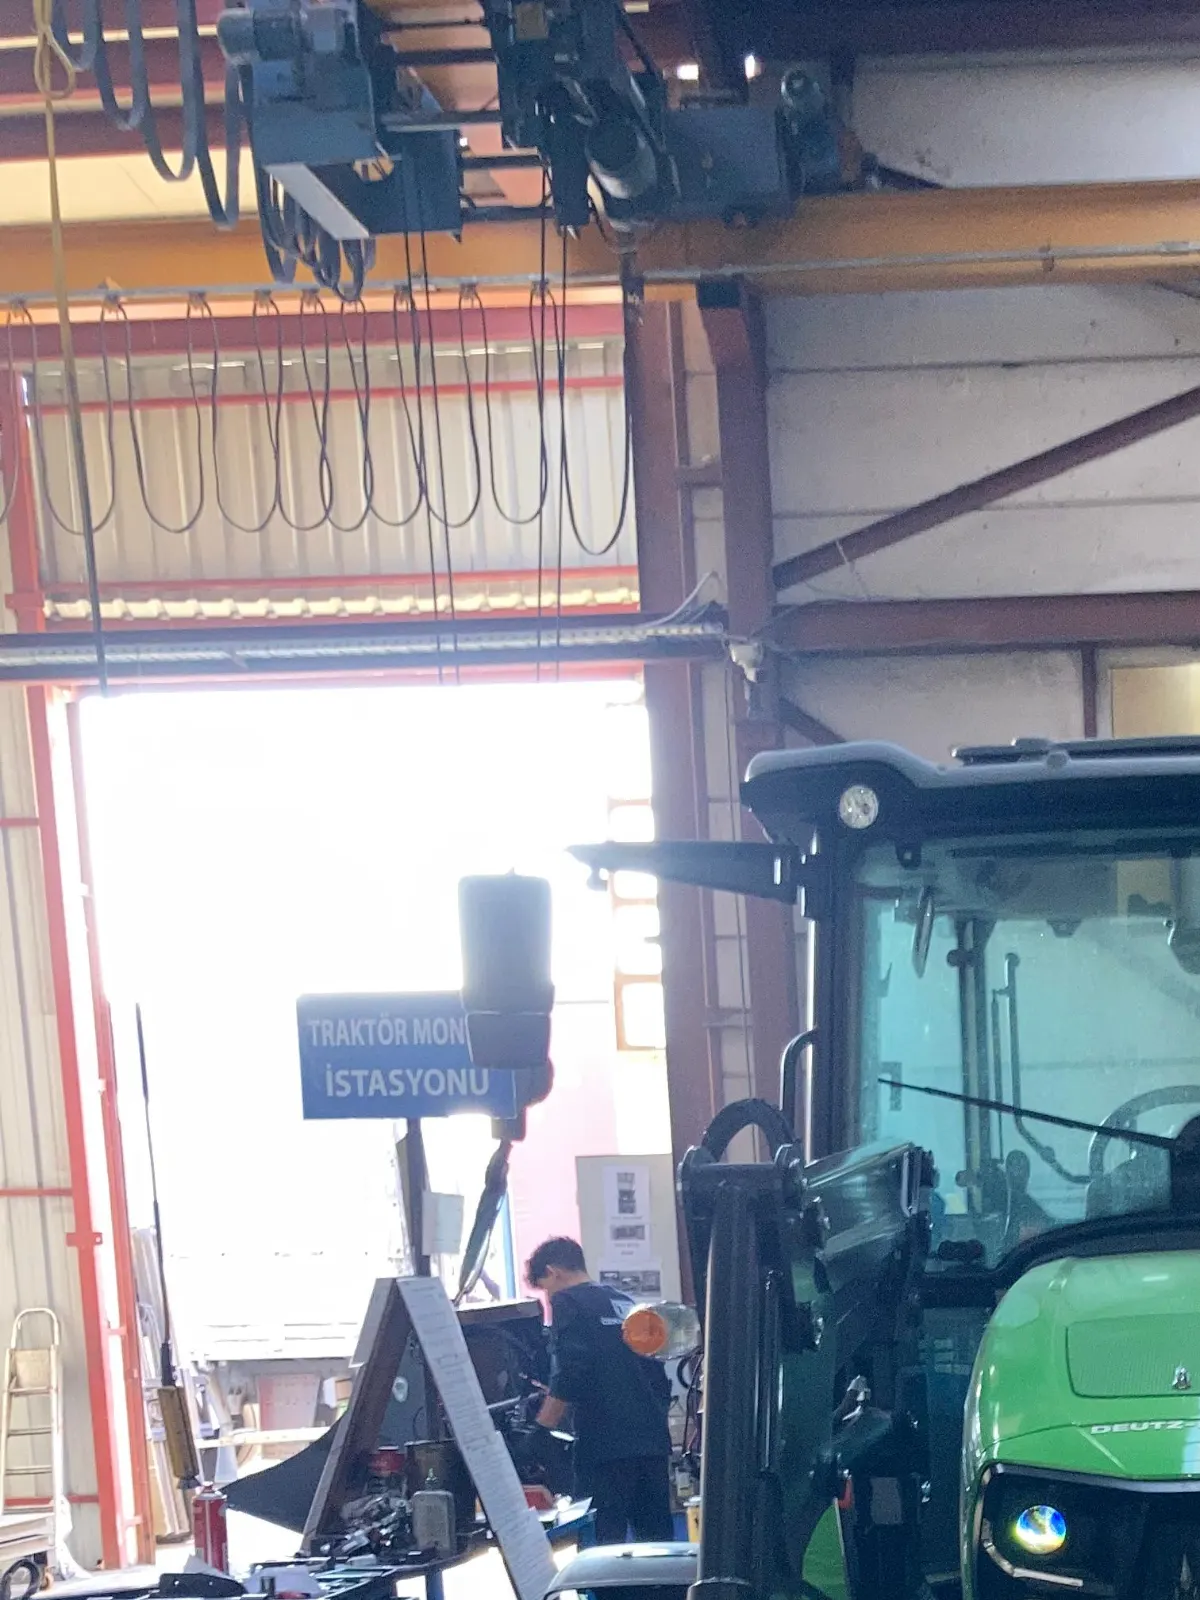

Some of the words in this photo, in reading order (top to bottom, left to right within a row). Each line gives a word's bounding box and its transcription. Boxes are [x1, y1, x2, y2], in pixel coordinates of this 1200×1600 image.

[307, 1012, 408, 1046] TRAKTÖR
[413, 1017, 466, 1045] MON
[326, 1064, 489, 1097] İSTASYONU
